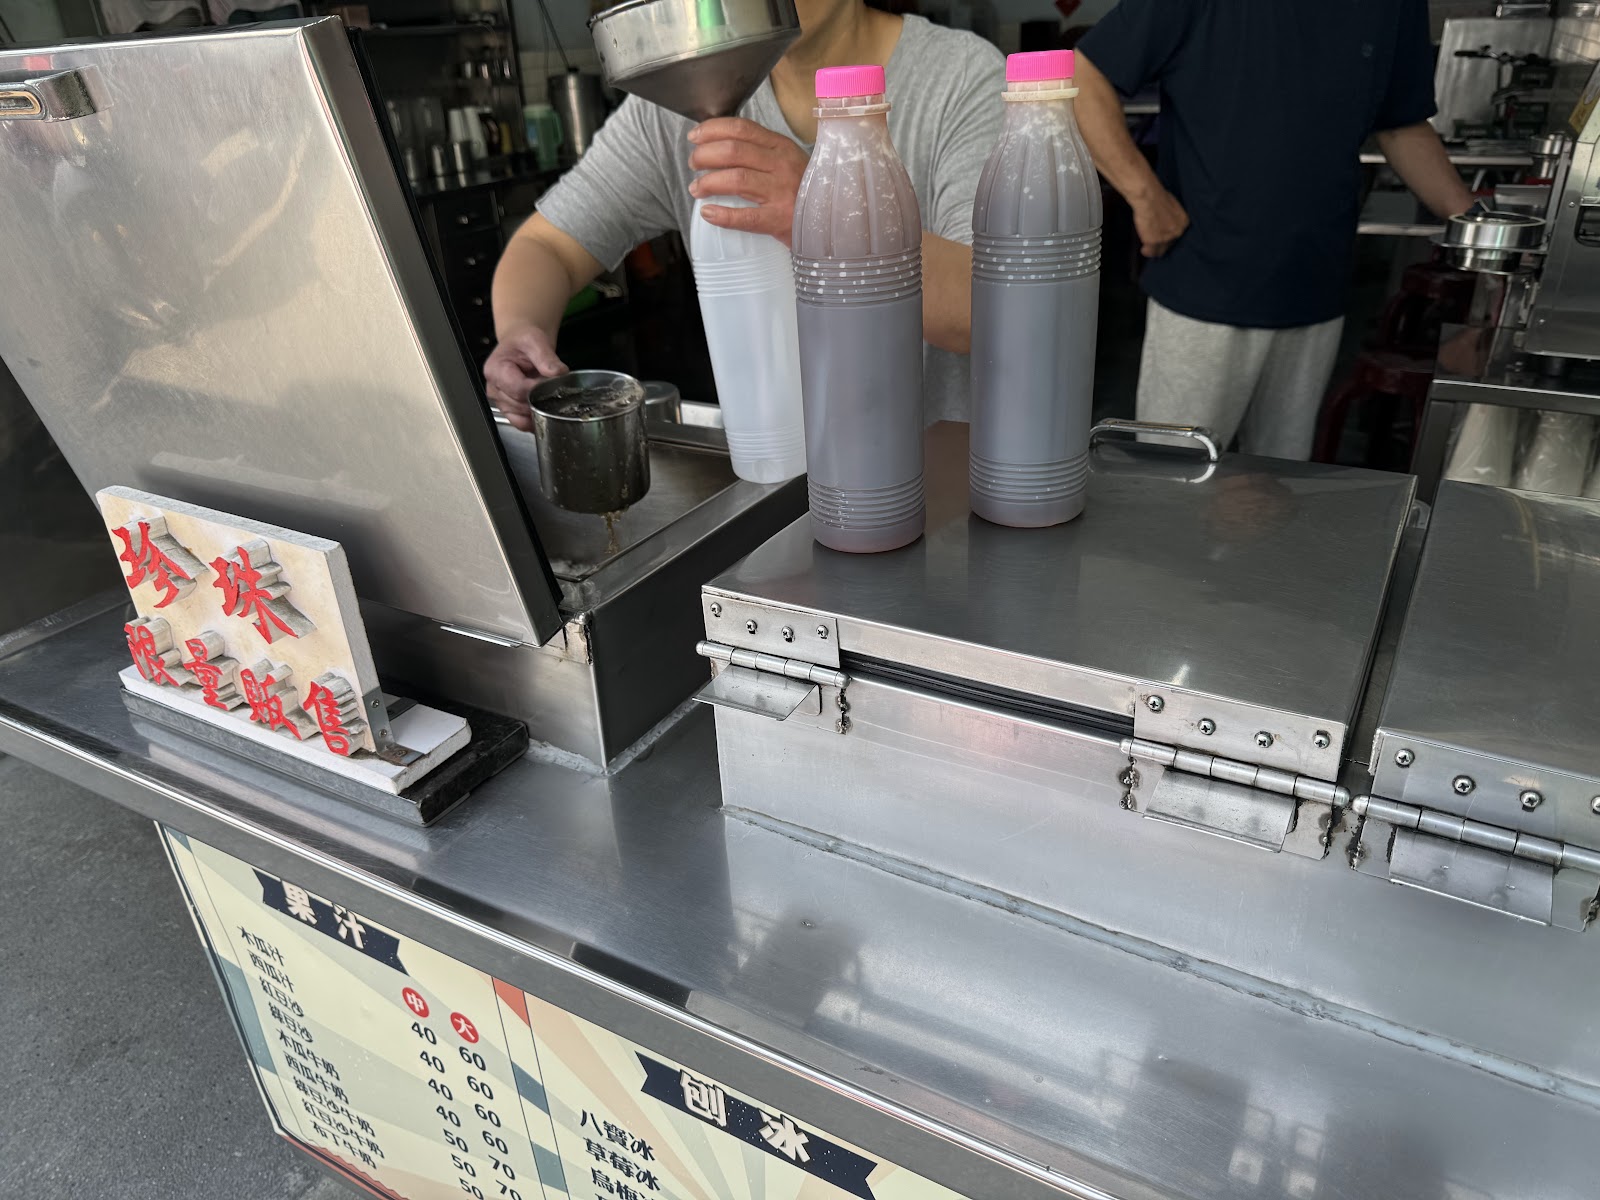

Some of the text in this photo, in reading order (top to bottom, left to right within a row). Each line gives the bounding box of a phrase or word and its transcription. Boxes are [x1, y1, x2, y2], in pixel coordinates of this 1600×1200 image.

[111, 521, 299, 644] 珍珠
[124, 624, 350, 756] 限量販售
[281, 880, 366, 949] 果汁
[236, 925, 487, 1072] 木瓜汁 40 60
[247, 949, 494, 1100] 西瓜汁 40 60
[259, 975, 502, 1128] 紅豆沙 40 60
[268, 1001, 508, 1155] 綠豆沙 40 60
[276, 1027, 516, 1181] 木瓜牛奶 50 70
[283, 1050, 523, 1200] 西瓜牛奶 50 70
[301, 1098, 385, 1159] 紅豆沙牛奶
[680, 1070, 811, 1163] 刨冰
[310, 1119, 377, 1170] 布丁牛奶
[458, 1176, 485, 1200] 50
[583, 1136, 660, 1191] 草莓冰
[591, 1166, 654, 1200] 烏梅
